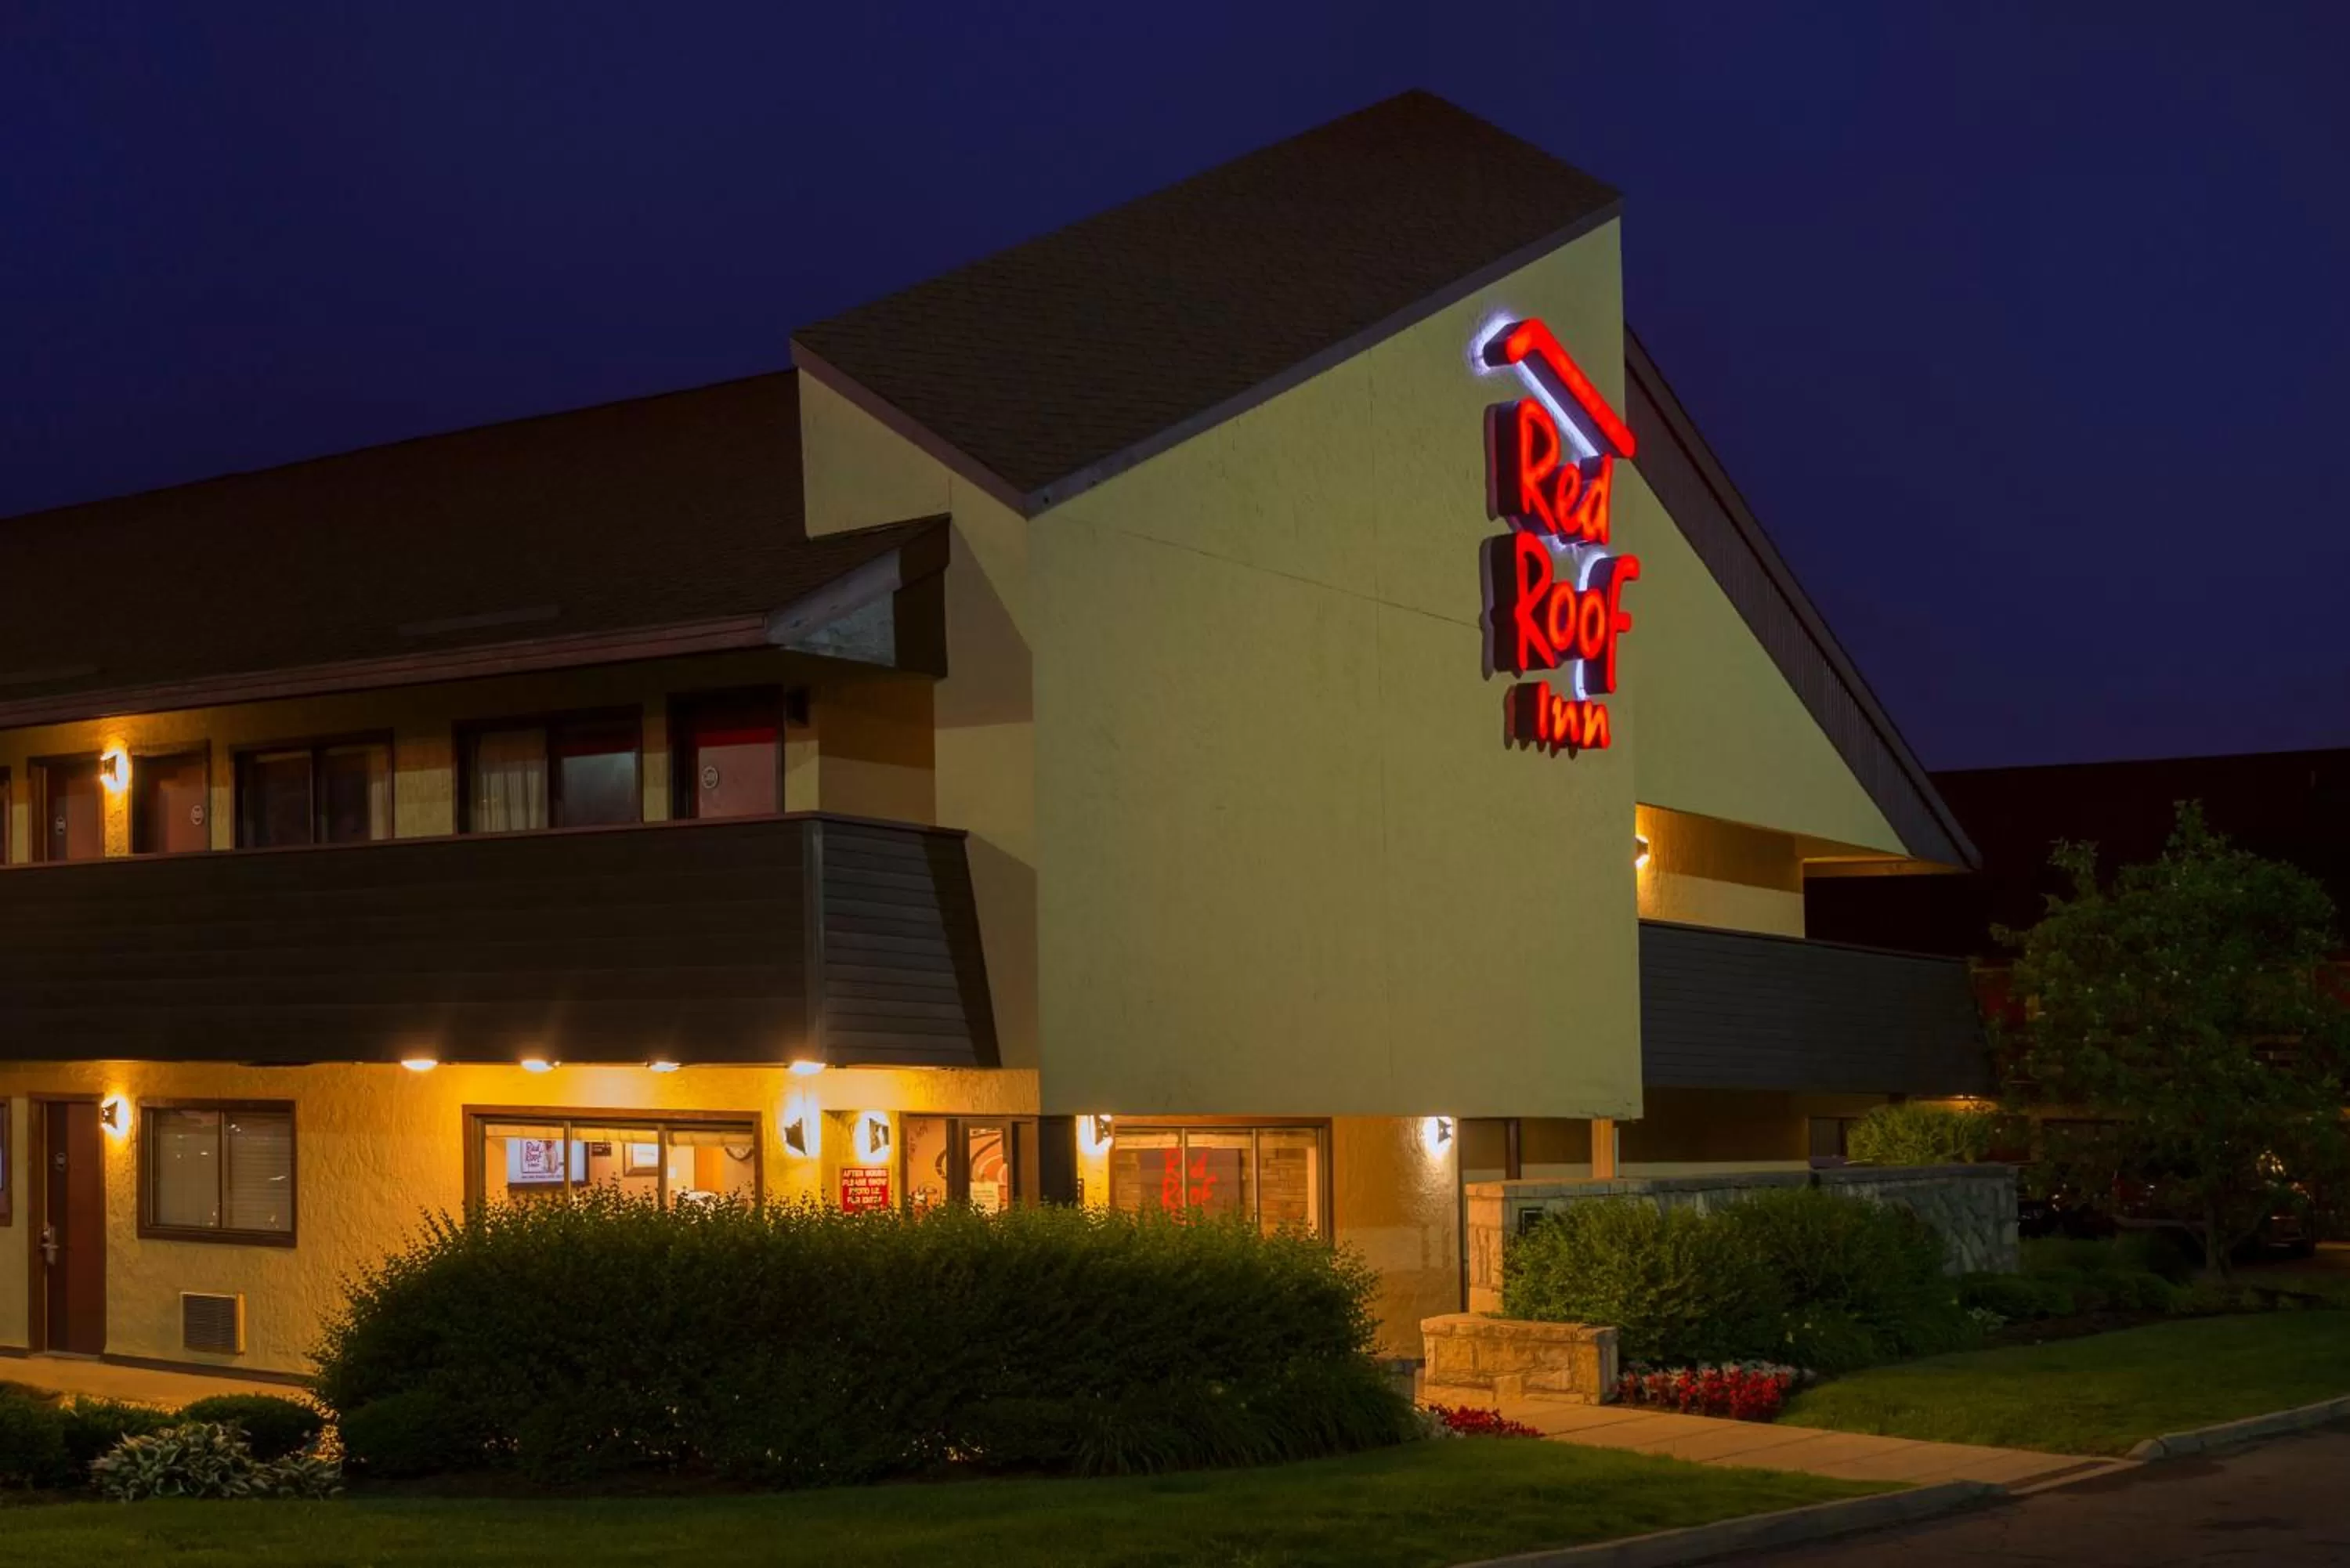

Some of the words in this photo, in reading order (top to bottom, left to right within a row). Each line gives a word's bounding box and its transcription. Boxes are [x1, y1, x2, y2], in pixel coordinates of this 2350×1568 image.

[1519, 396, 1614, 545] Red
[1514, 531, 1640, 693] Roof
[1538, 681, 1611, 750] Inn
[1165, 1147, 1207, 1179] Rd
